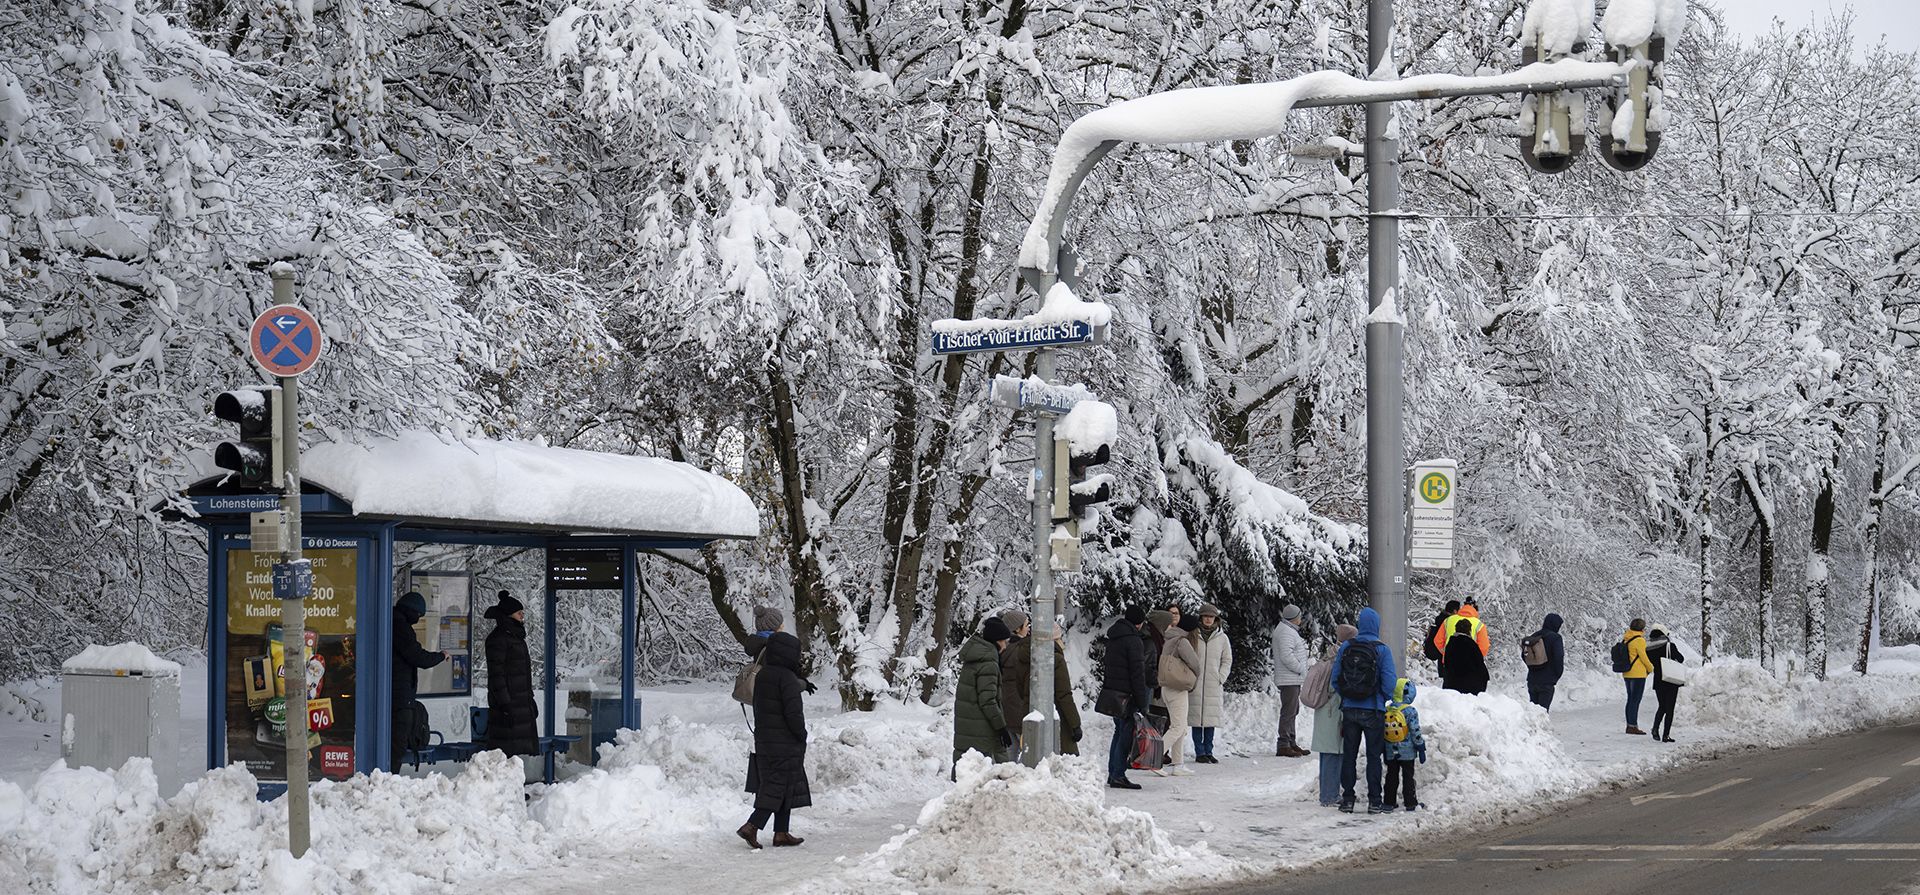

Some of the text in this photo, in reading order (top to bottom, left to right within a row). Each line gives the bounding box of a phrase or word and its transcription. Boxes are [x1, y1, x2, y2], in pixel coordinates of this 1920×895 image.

[939, 320, 1082, 350] Fischer-von-Erlach-Str.
[1427, 479, 1442, 497] H
[210, 497, 281, 509] Lohensteinstr
[312, 587, 334, 600] 300
[325, 751, 349, 760] REWE
